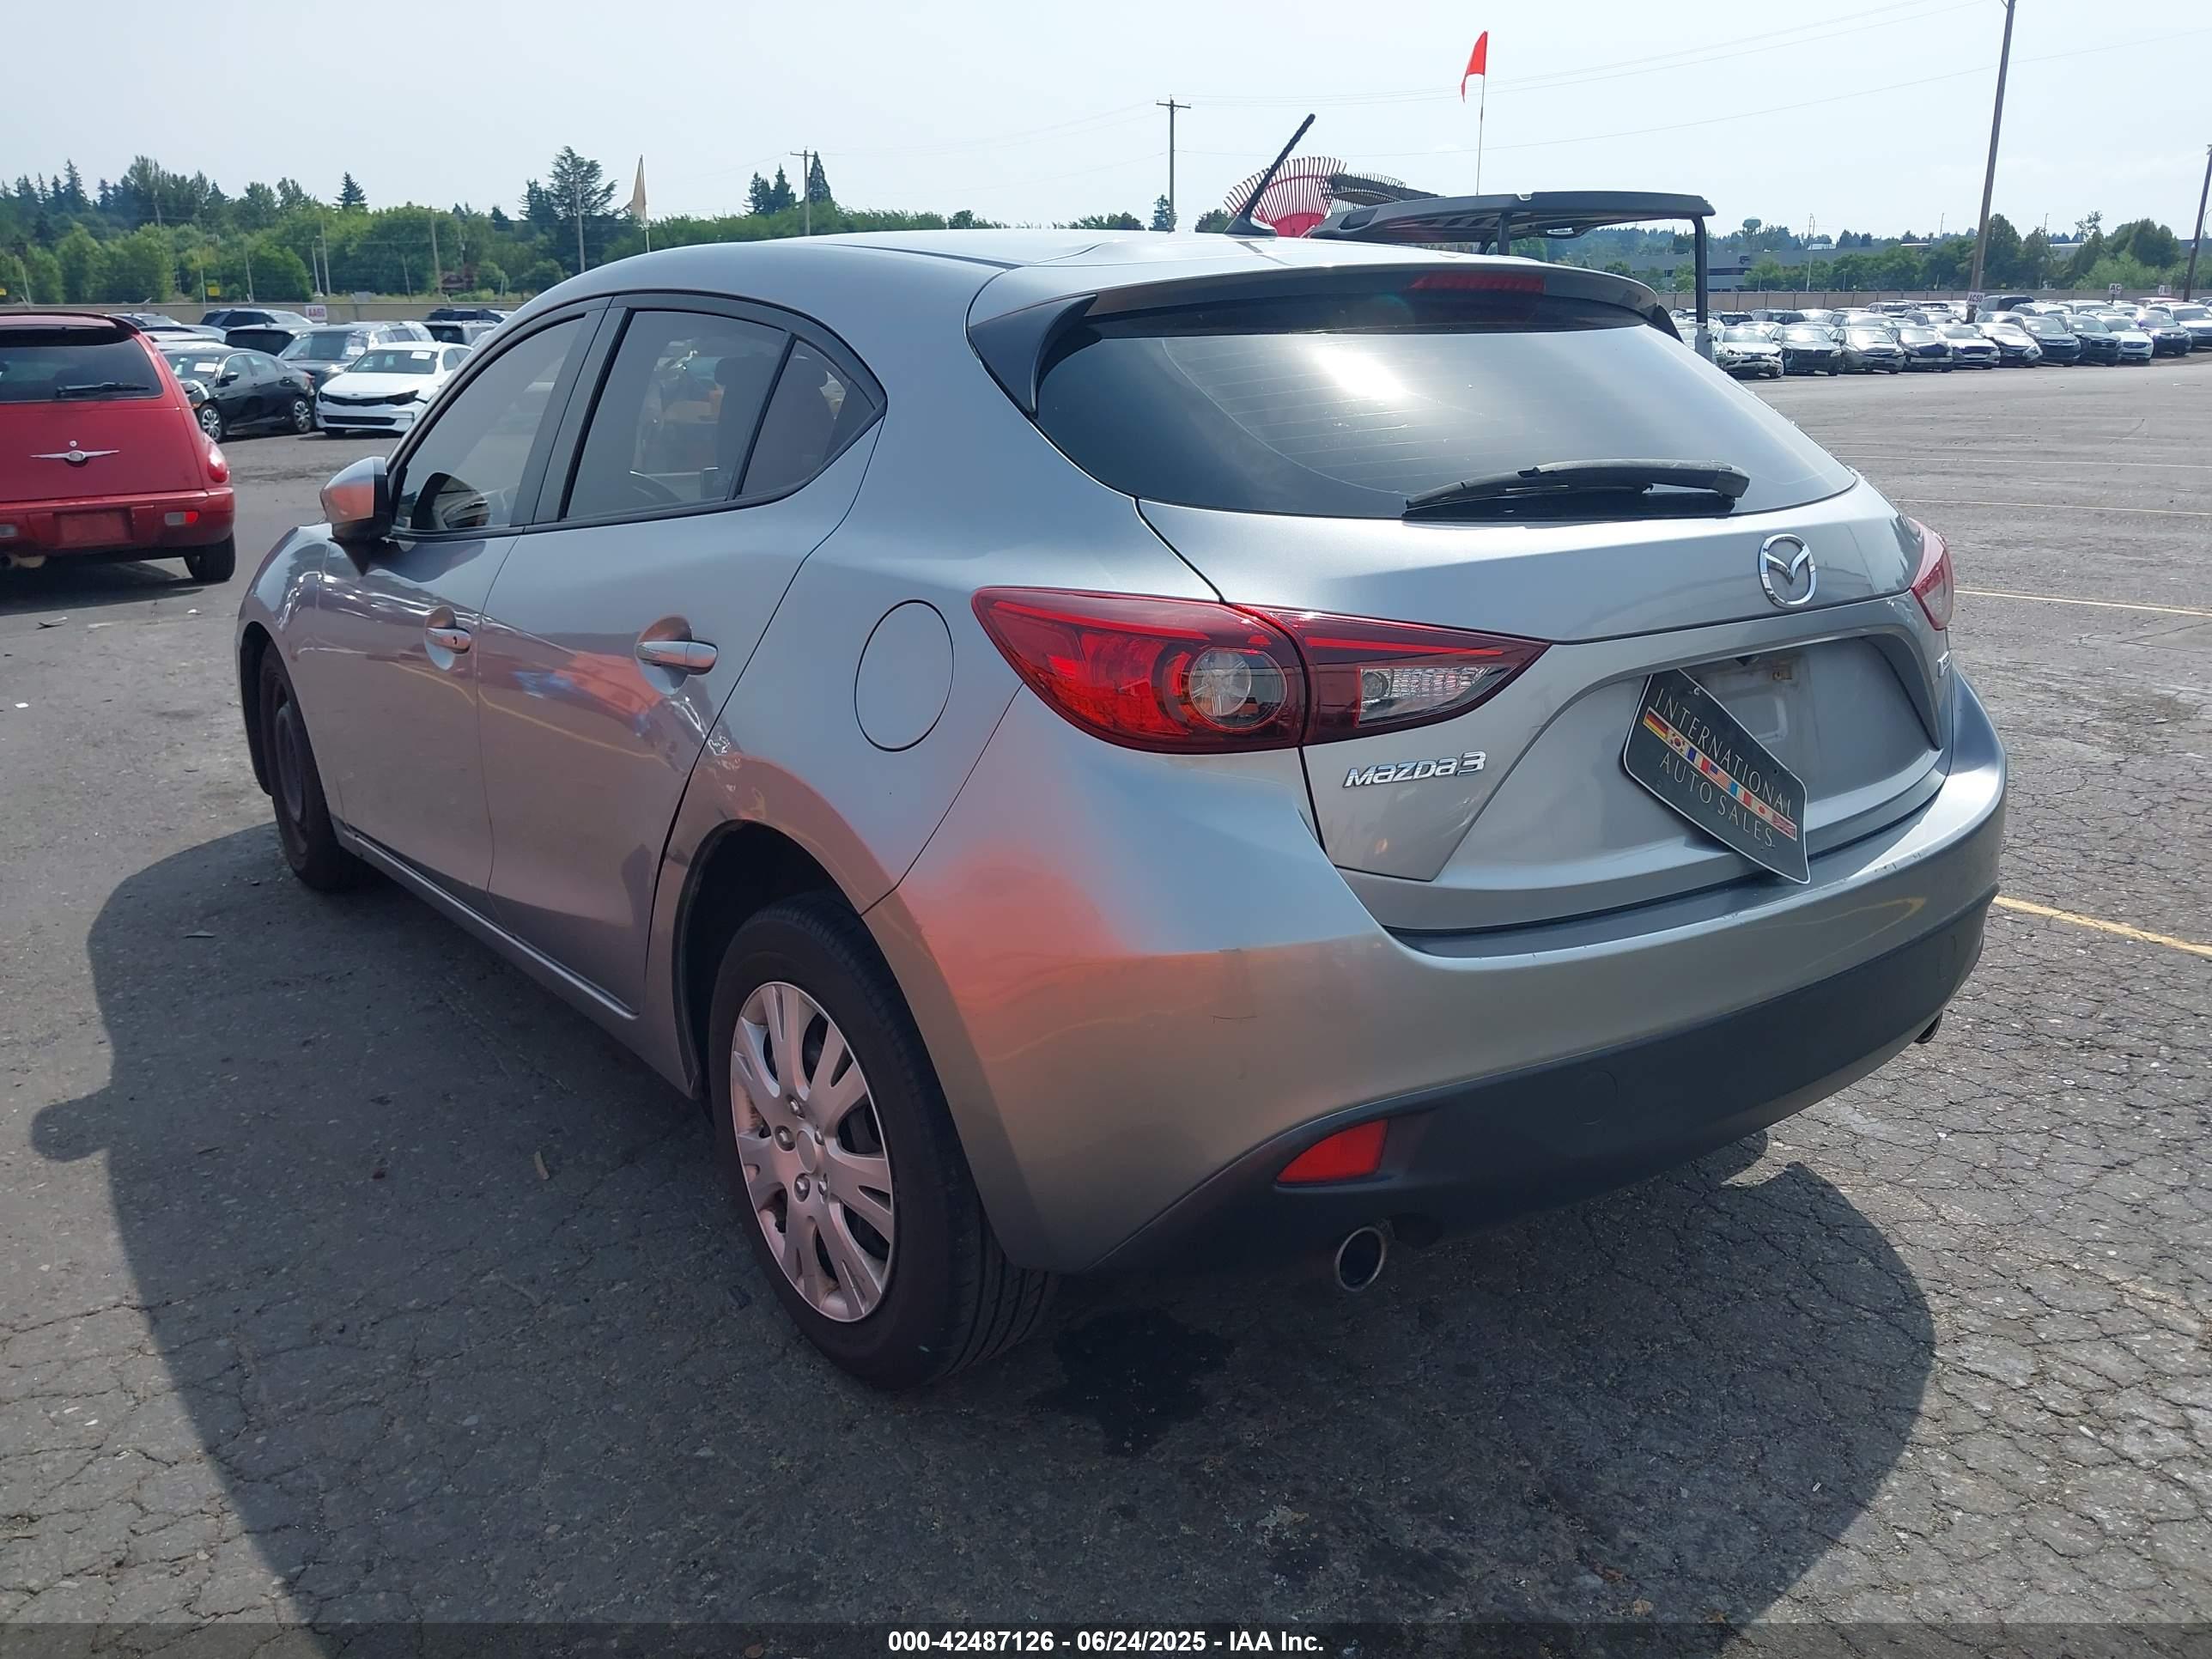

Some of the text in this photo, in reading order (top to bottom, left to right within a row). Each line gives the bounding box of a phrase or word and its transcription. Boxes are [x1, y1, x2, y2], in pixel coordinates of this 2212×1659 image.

[1655, 688, 1794, 820] INTERNATIONAL
[1659, 752, 1773, 847] AUTO SALES
